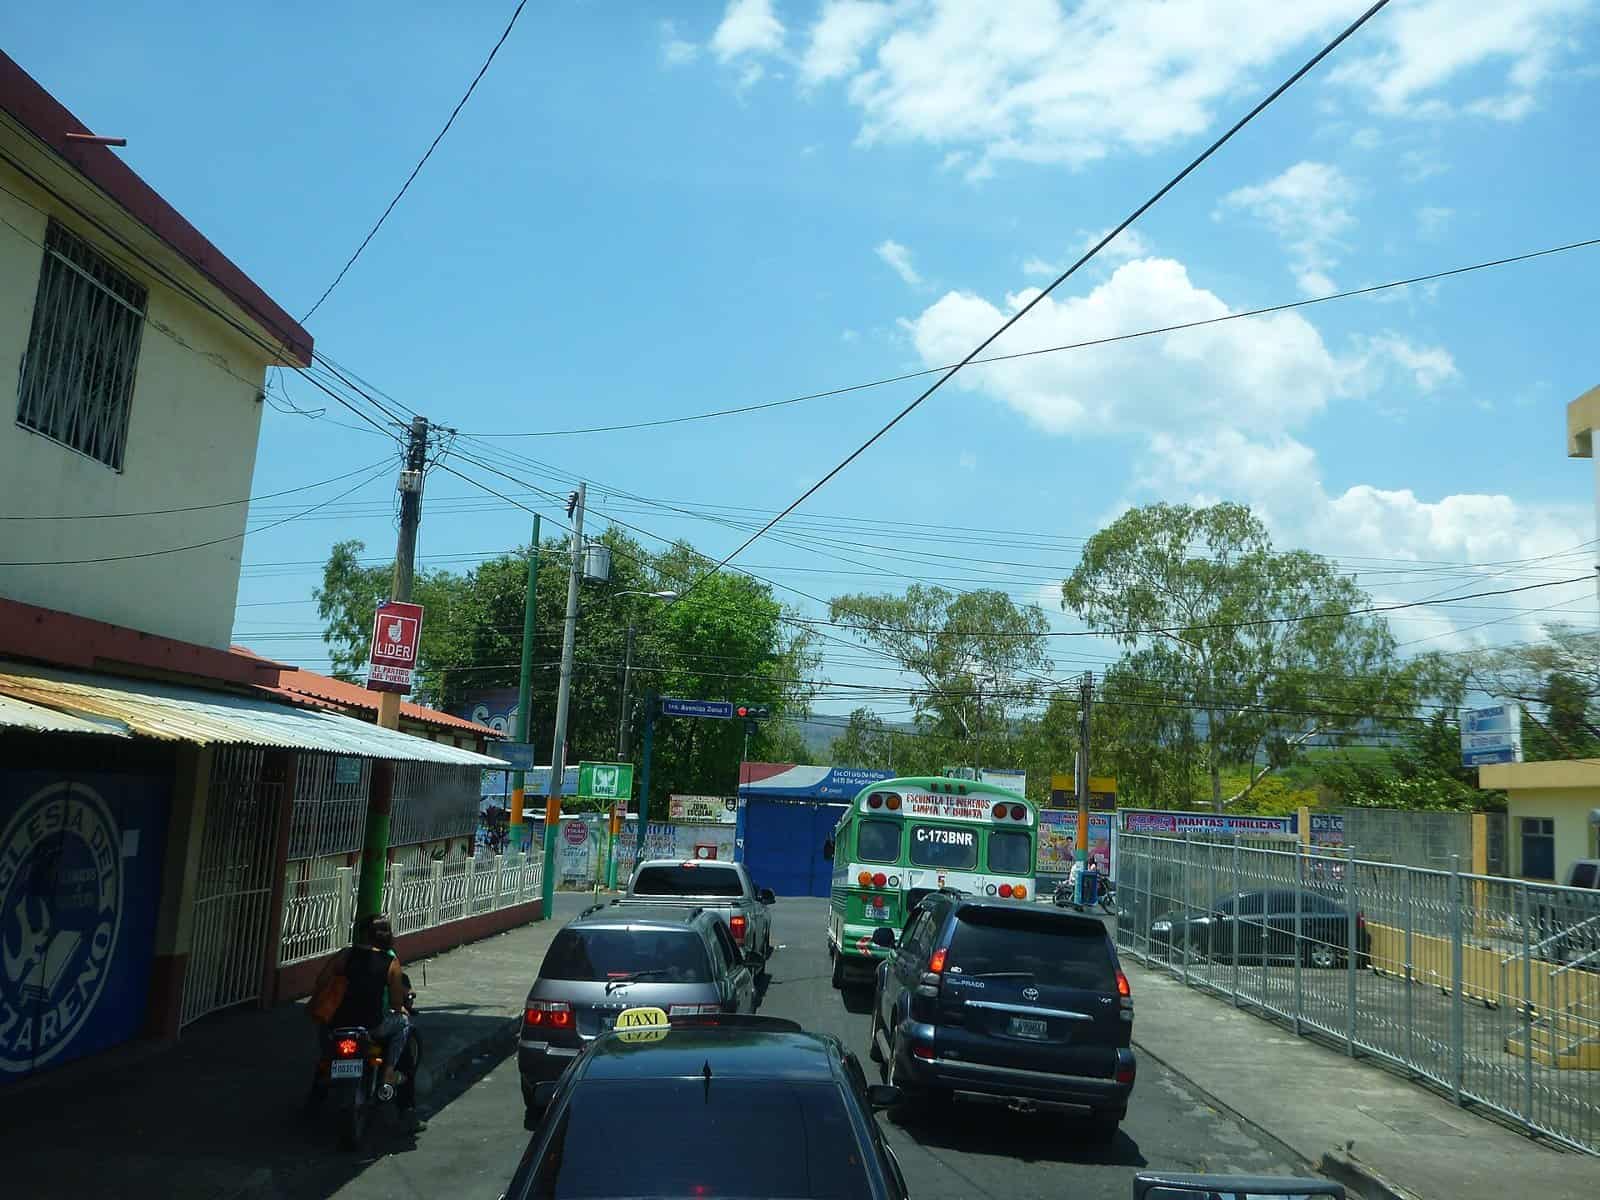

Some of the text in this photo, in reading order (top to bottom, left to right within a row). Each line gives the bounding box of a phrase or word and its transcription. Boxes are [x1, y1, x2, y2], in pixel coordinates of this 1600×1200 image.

[377, 641, 410, 658] LIDER
[595, 785, 615, 794] UNE
[1177, 816, 1224, 827] MANTAS
[916, 828, 973, 846] C-173BNR
[623, 1012, 658, 1026] TAXI
